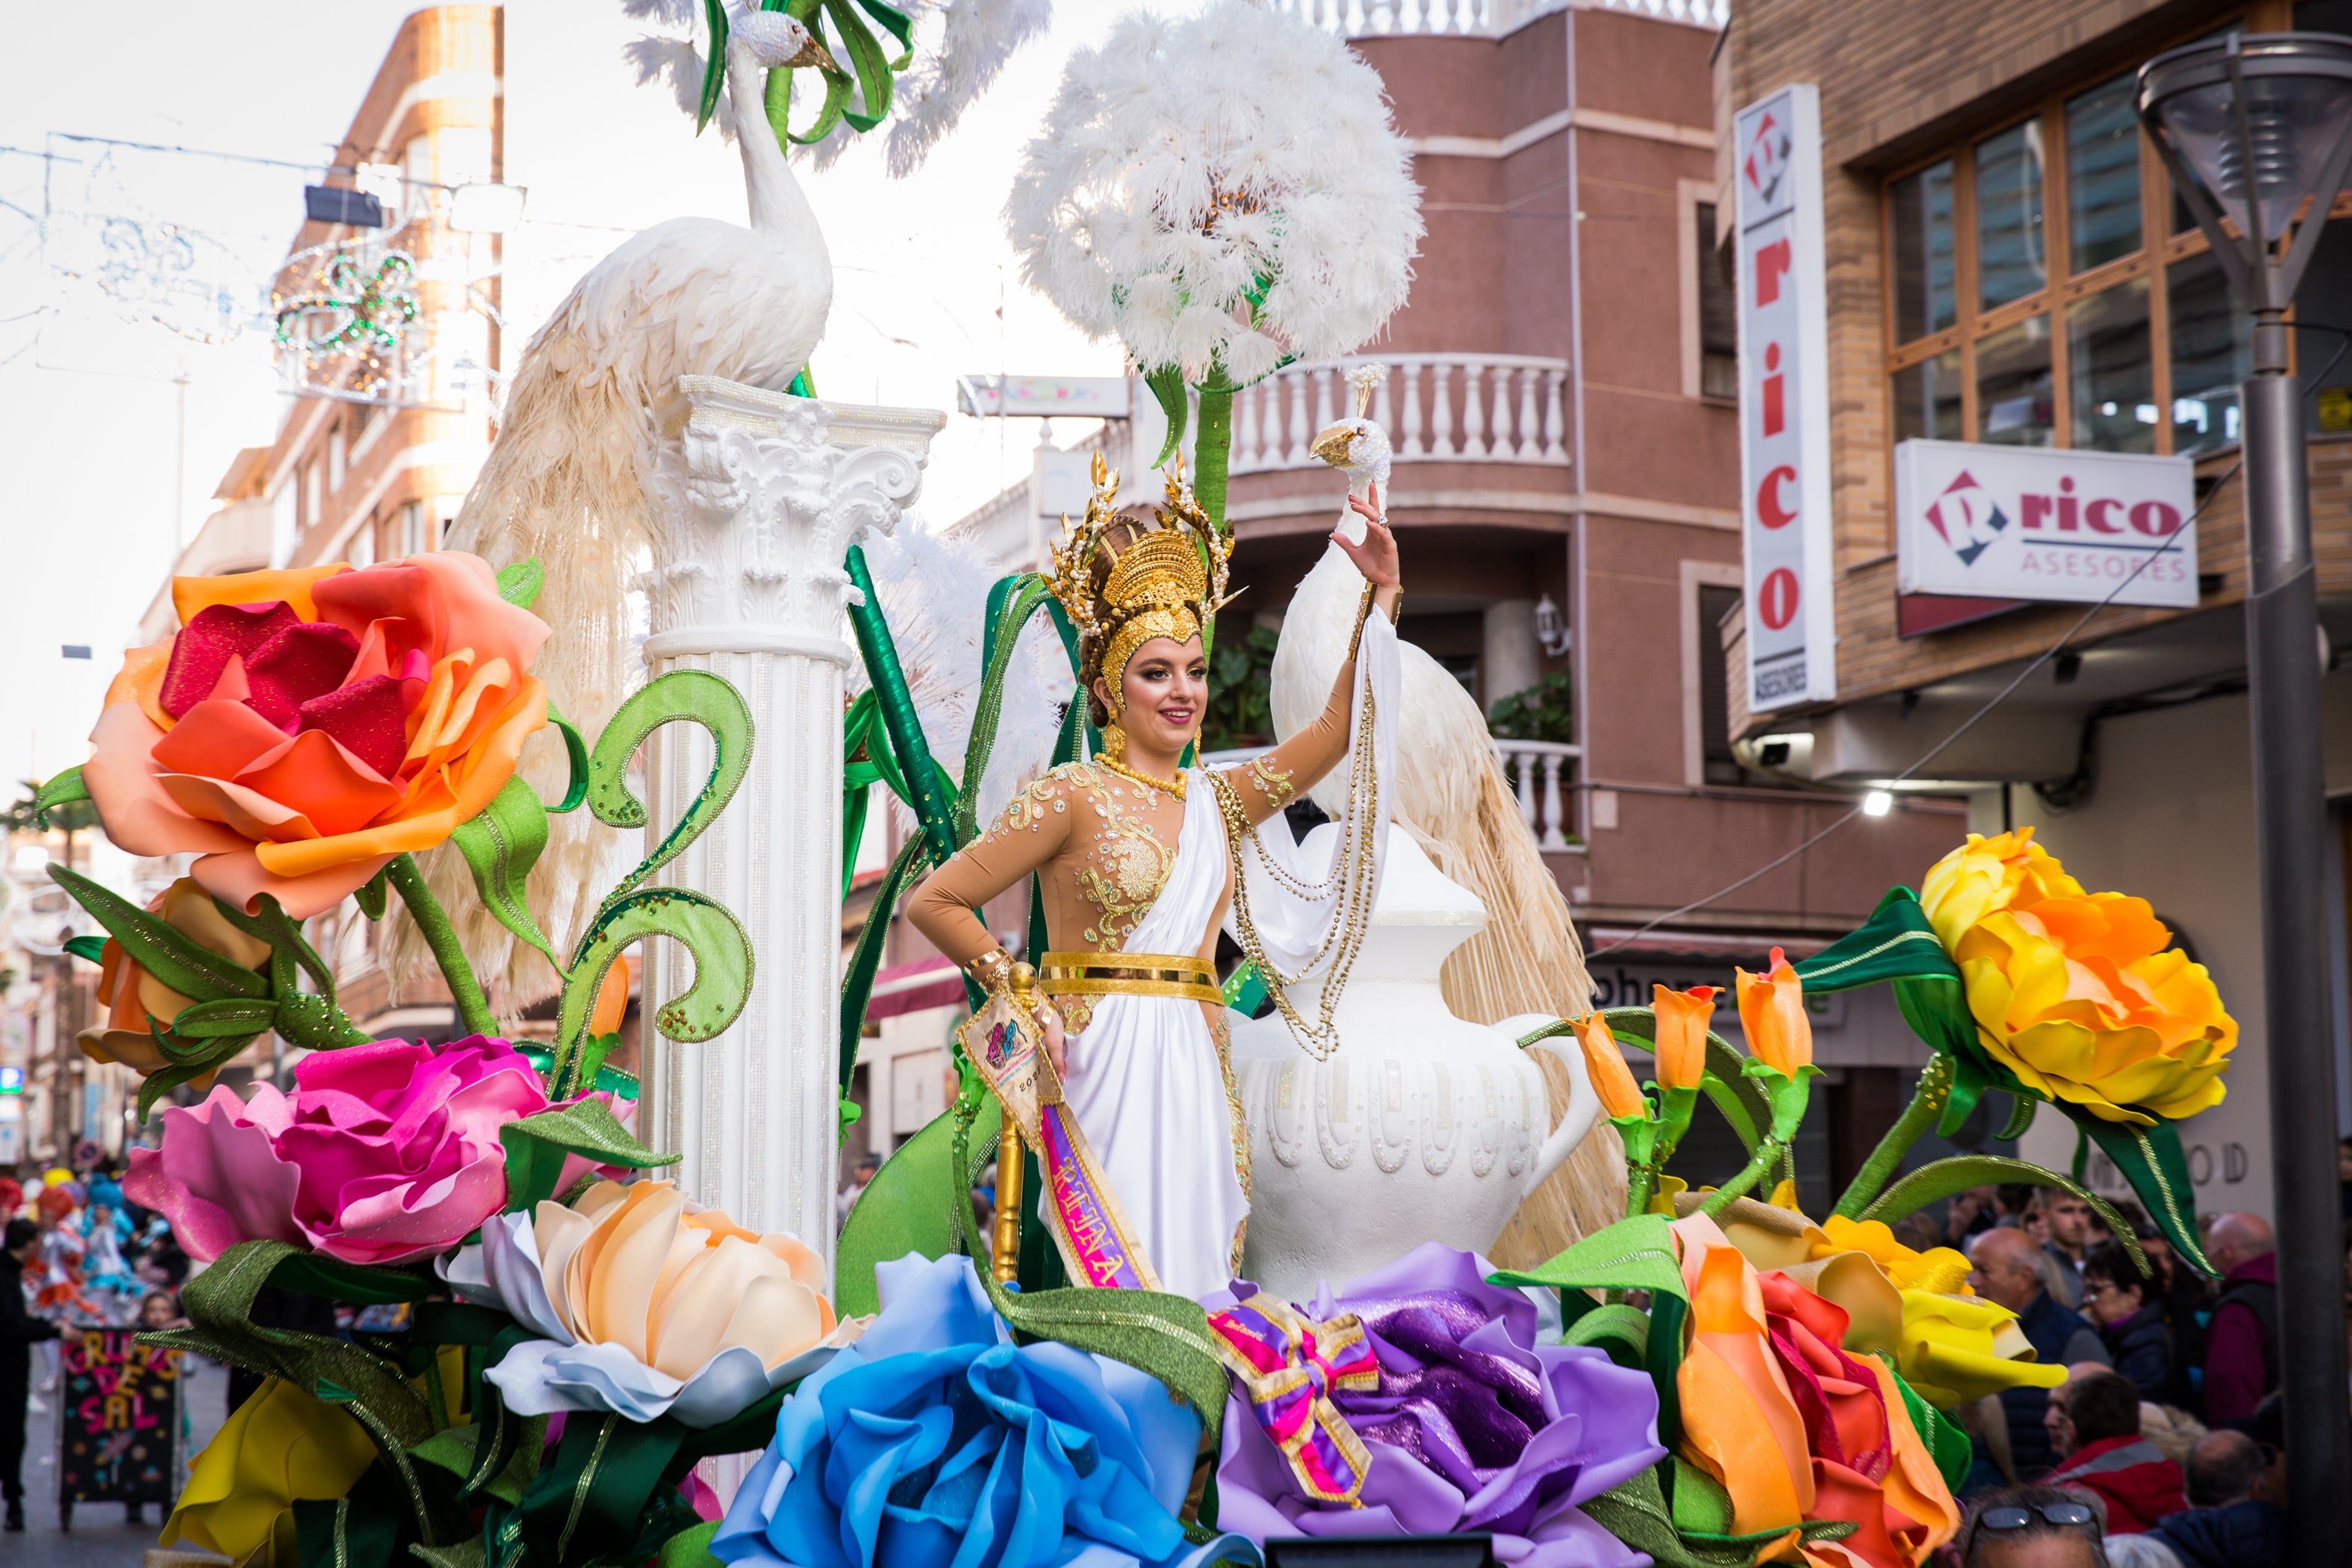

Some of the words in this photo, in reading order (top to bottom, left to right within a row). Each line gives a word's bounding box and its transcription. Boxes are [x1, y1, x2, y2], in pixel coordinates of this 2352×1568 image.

[1755, 236, 1798, 631] rico
[2020, 476, 2182, 538] rico
[2020, 550, 2187, 583] ASESORES
[92, 1364, 146, 1397] DE
[78, 1392, 159, 1435] SAL
